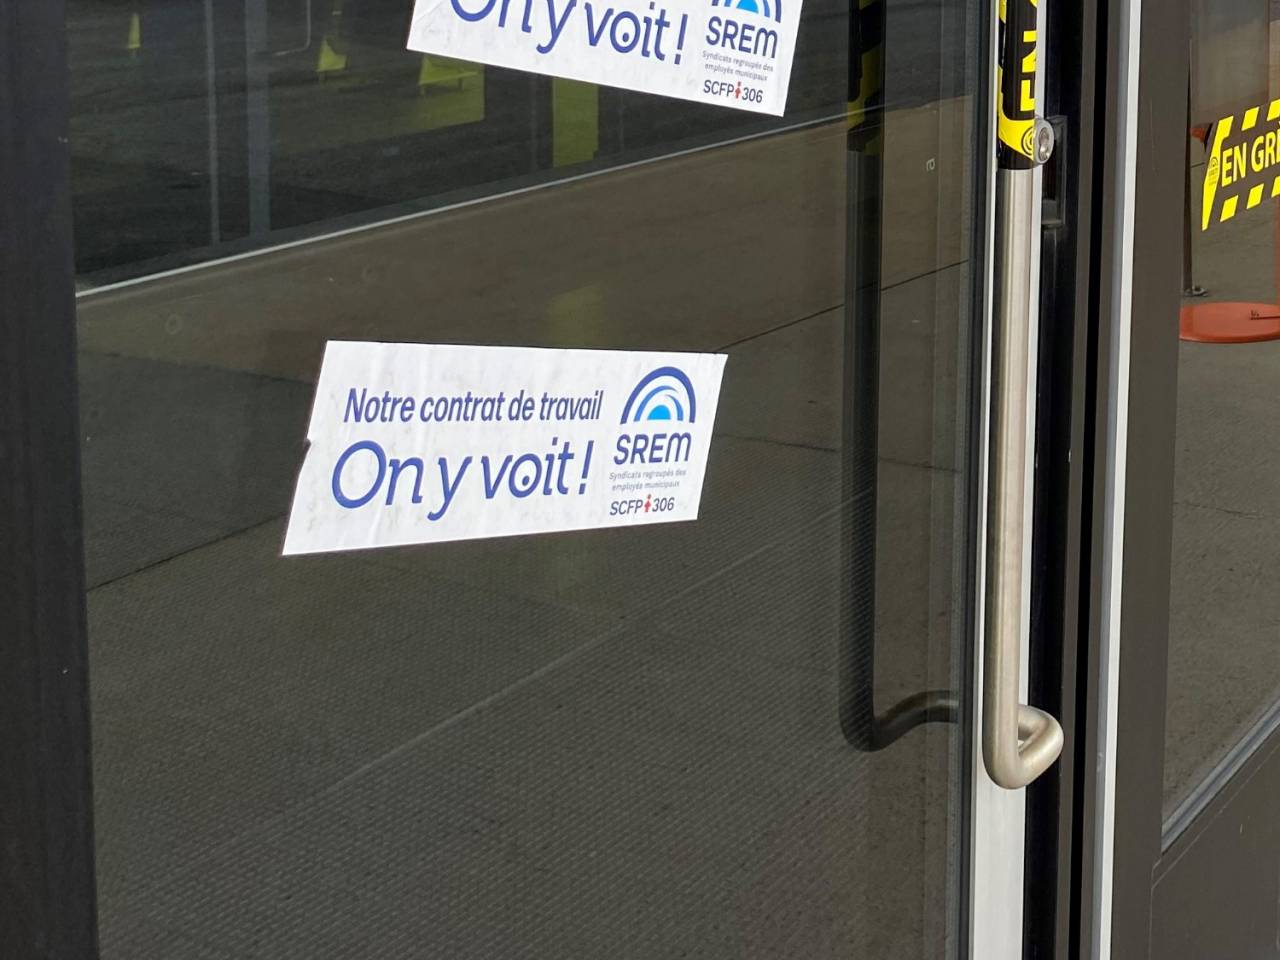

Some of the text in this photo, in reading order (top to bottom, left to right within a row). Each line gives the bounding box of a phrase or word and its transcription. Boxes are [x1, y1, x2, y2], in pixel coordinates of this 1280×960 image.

[705, 15, 778, 59] SREM
[703, 79, 764, 103] SCFP 306
[1221, 142, 1247, 188] EN
[343, 387, 603, 423] Notre contrat de travail
[613, 432, 692, 465] SREM
[331, 440, 423, 509] On
[427, 455, 473, 521] y
[610, 496, 675, 516] SCFP 306
